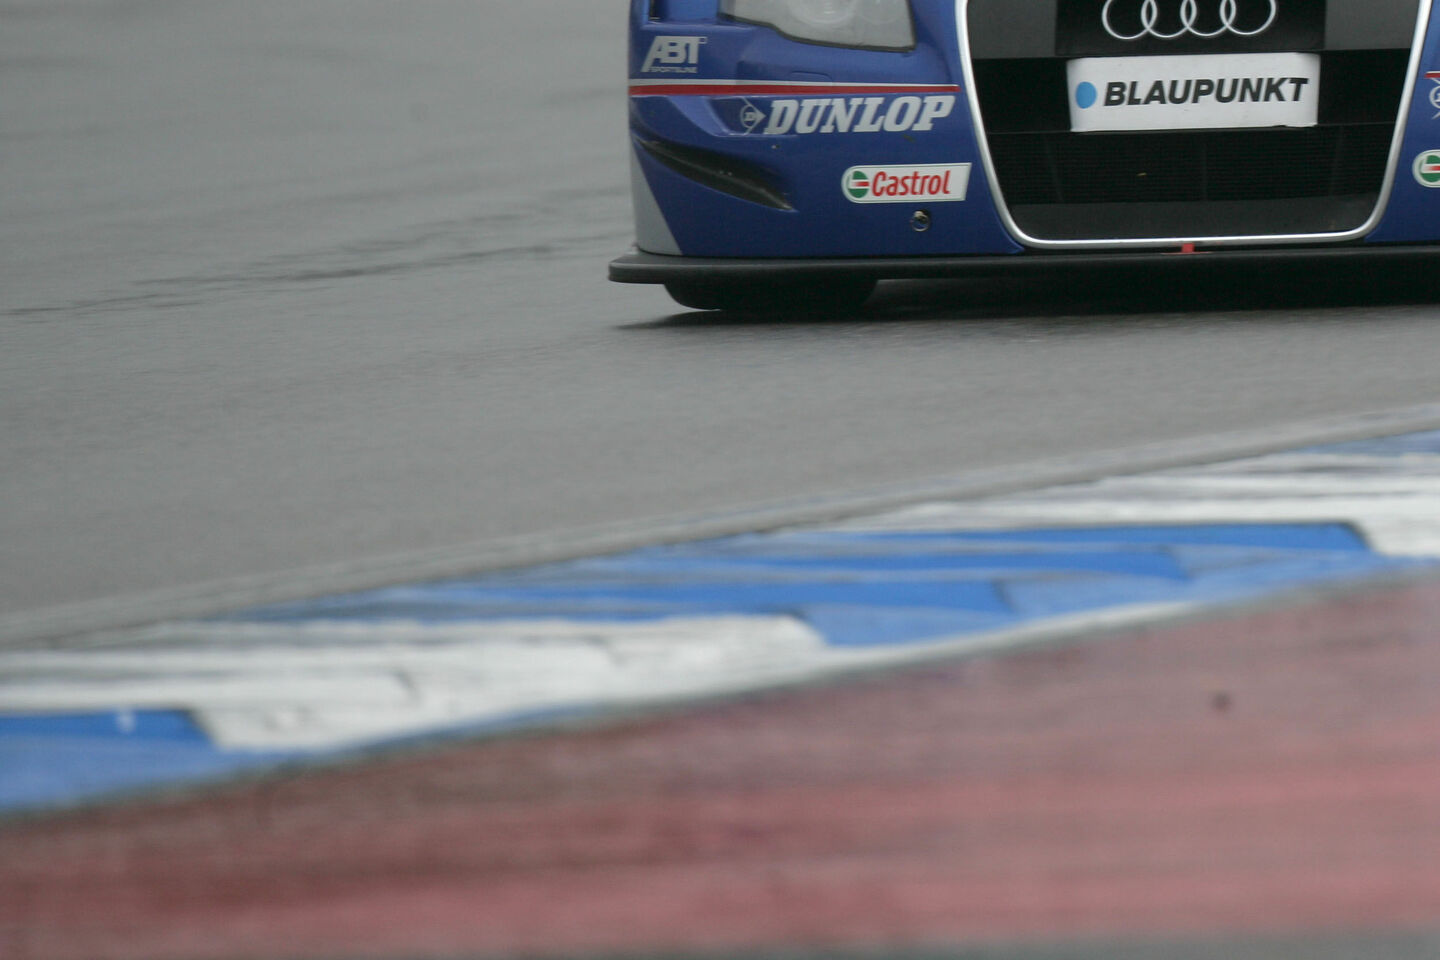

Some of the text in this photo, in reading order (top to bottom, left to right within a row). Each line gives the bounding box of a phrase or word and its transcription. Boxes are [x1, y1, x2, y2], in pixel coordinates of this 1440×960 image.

[640, 35, 700, 73] ABT
[1103, 76, 1310, 108] BLAUPUNKT
[763, 94, 956, 136] DUNLOP
[871, 169, 951, 198] Castrol
